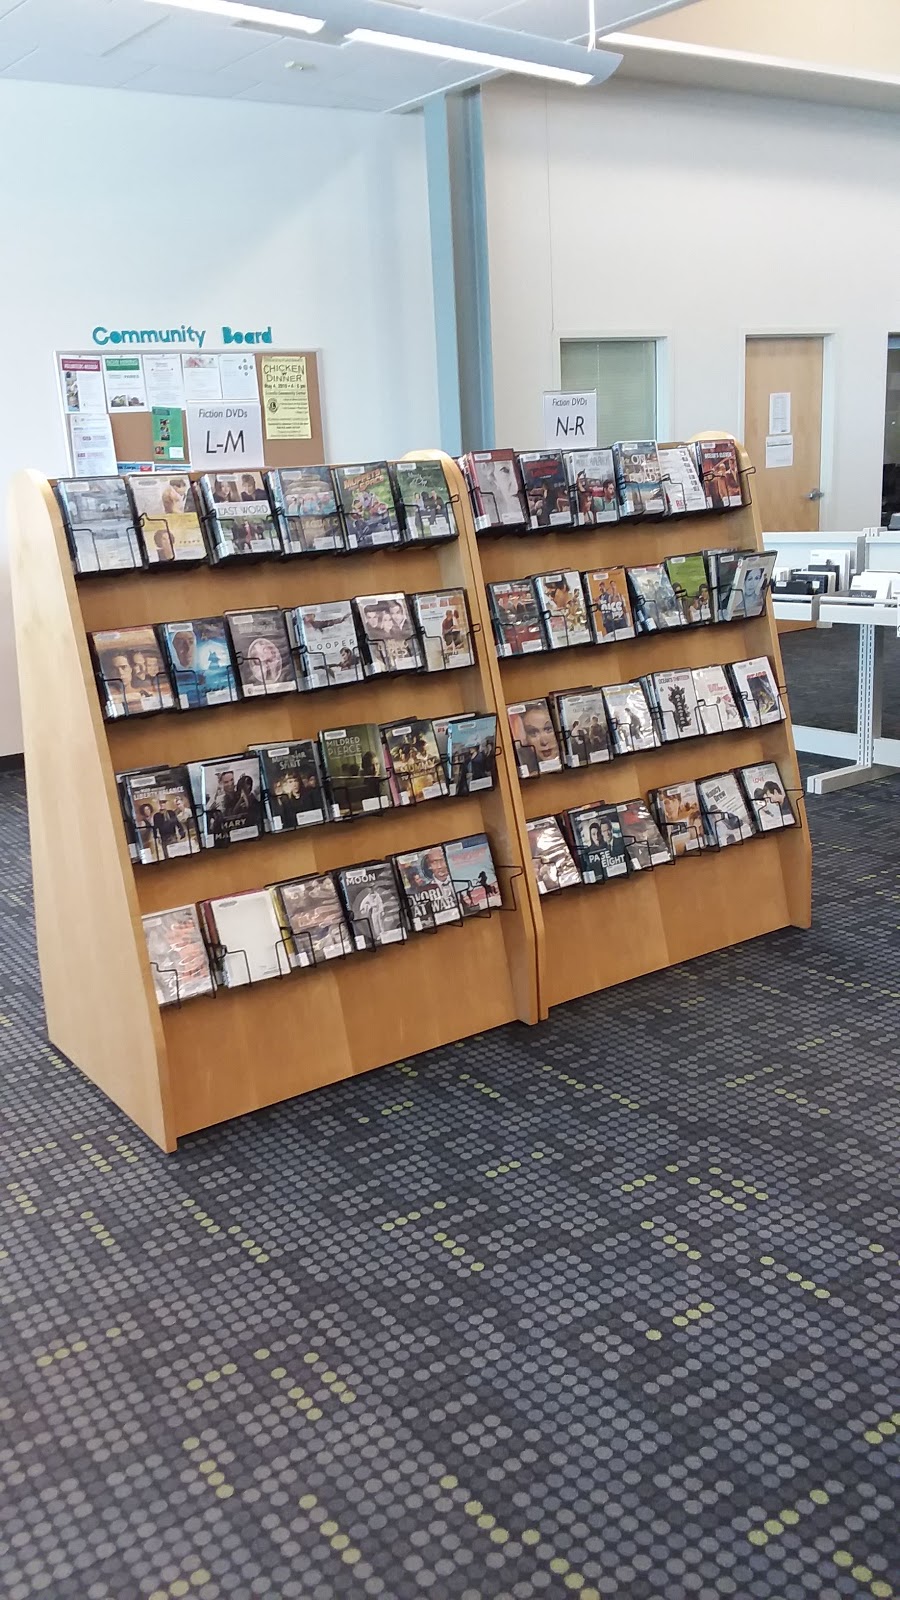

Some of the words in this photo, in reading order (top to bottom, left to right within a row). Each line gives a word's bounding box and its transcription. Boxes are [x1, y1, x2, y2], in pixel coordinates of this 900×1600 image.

[92, 325, 206, 348] Community
[222, 326, 272, 345] Board
[263, 364, 305, 375] CHICKEN
[266, 374, 302, 382] DINNER
[552, 398, 570, 406] Fiction
[572, 397, 587, 406] DVDs
[198, 408, 223, 419] Fiction
[225, 408, 248, 418] DVDs
[556, 415, 585, 437] N-R
[205, 429, 245, 454] L-M
[218, 506, 238, 515] LAST
[242, 504, 269, 514] WORD
[309, 639, 355, 651] LOOPER
[326, 736, 361, 747] MILDRED
[327, 744, 361, 756] PIERCE
[221, 817, 247, 829] MARY
[589, 850, 611, 863] PAGE
[601, 854, 625, 868] EIGHT
[346, 873, 376, 886] MOON
[414, 903, 428, 918] AT
[431, 897, 456, 913] WAR
